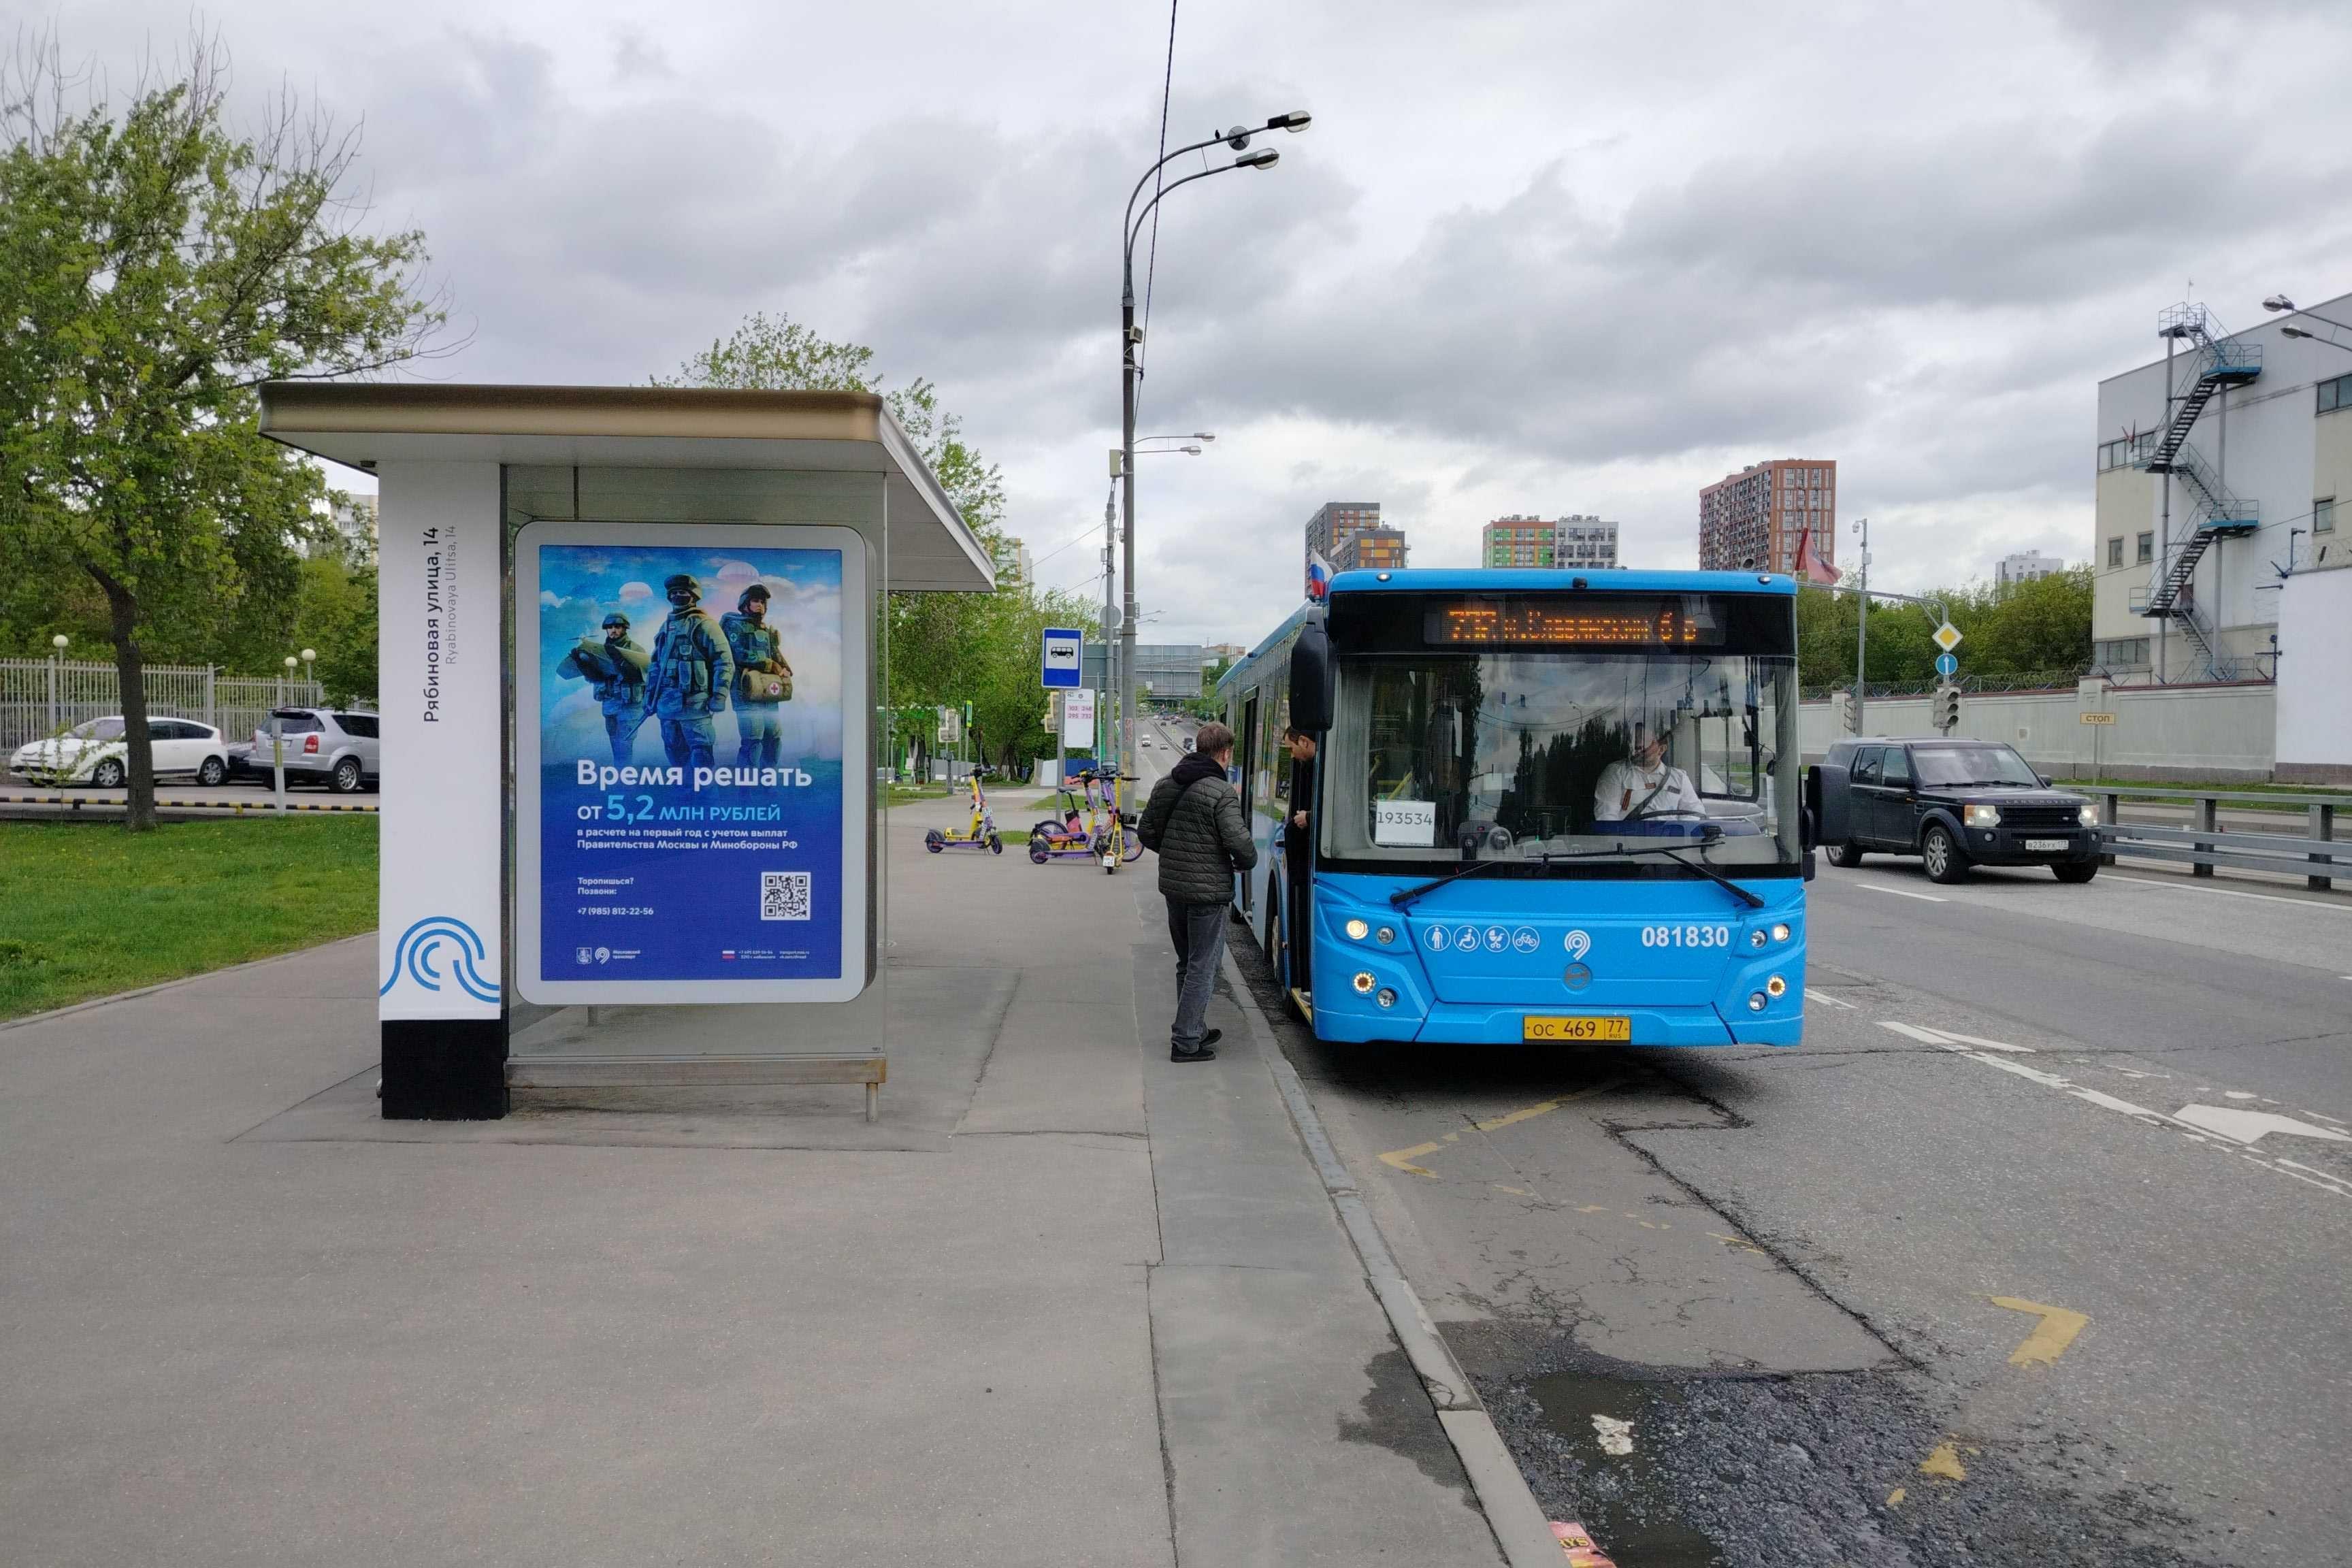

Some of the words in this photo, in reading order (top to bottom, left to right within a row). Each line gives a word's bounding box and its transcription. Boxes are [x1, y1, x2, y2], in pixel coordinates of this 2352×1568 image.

[423, 527, 438, 546] 14
[444, 525, 456, 538] 14
[444, 541, 457, 581] Ulitsa,
[427, 551, 442, 613] улица,
[445, 585, 458, 664] Ryabinovaya
[423, 619, 439, 722] Рябиновая
[578, 760, 683, 791] Время
[693, 766, 813, 792] решать
[607, 795, 654, 825] 5,2
[659, 807, 704, 821] МЛН
[710, 804, 781, 821] РУБЛЕЙ
[1377, 811, 1433, 826] 193534
[585, 829, 626, 838] расчете
[643, 828, 683, 838] первый
[685, 830, 702, 838] год
[712, 830, 749, 838] учетом
[577, 840, 655, 850] Правительства
[657, 840, 700, 849] Москвы
[710, 840, 780, 851] Минобороны
[782, 840, 798, 849] РФ
[577, 877, 634, 886] Торопишься?
[577, 907, 587, 915] +7
[588, 906, 610, 915] (985)
[612, 907, 654, 915] 812-22-56
[1642, 926, 1729, 947] 081830
[1533, 1024, 1555, 1036] ОС
[1563, 1020, 1596, 1037] 469
[1607, 1019, 1624, 1033] 77
